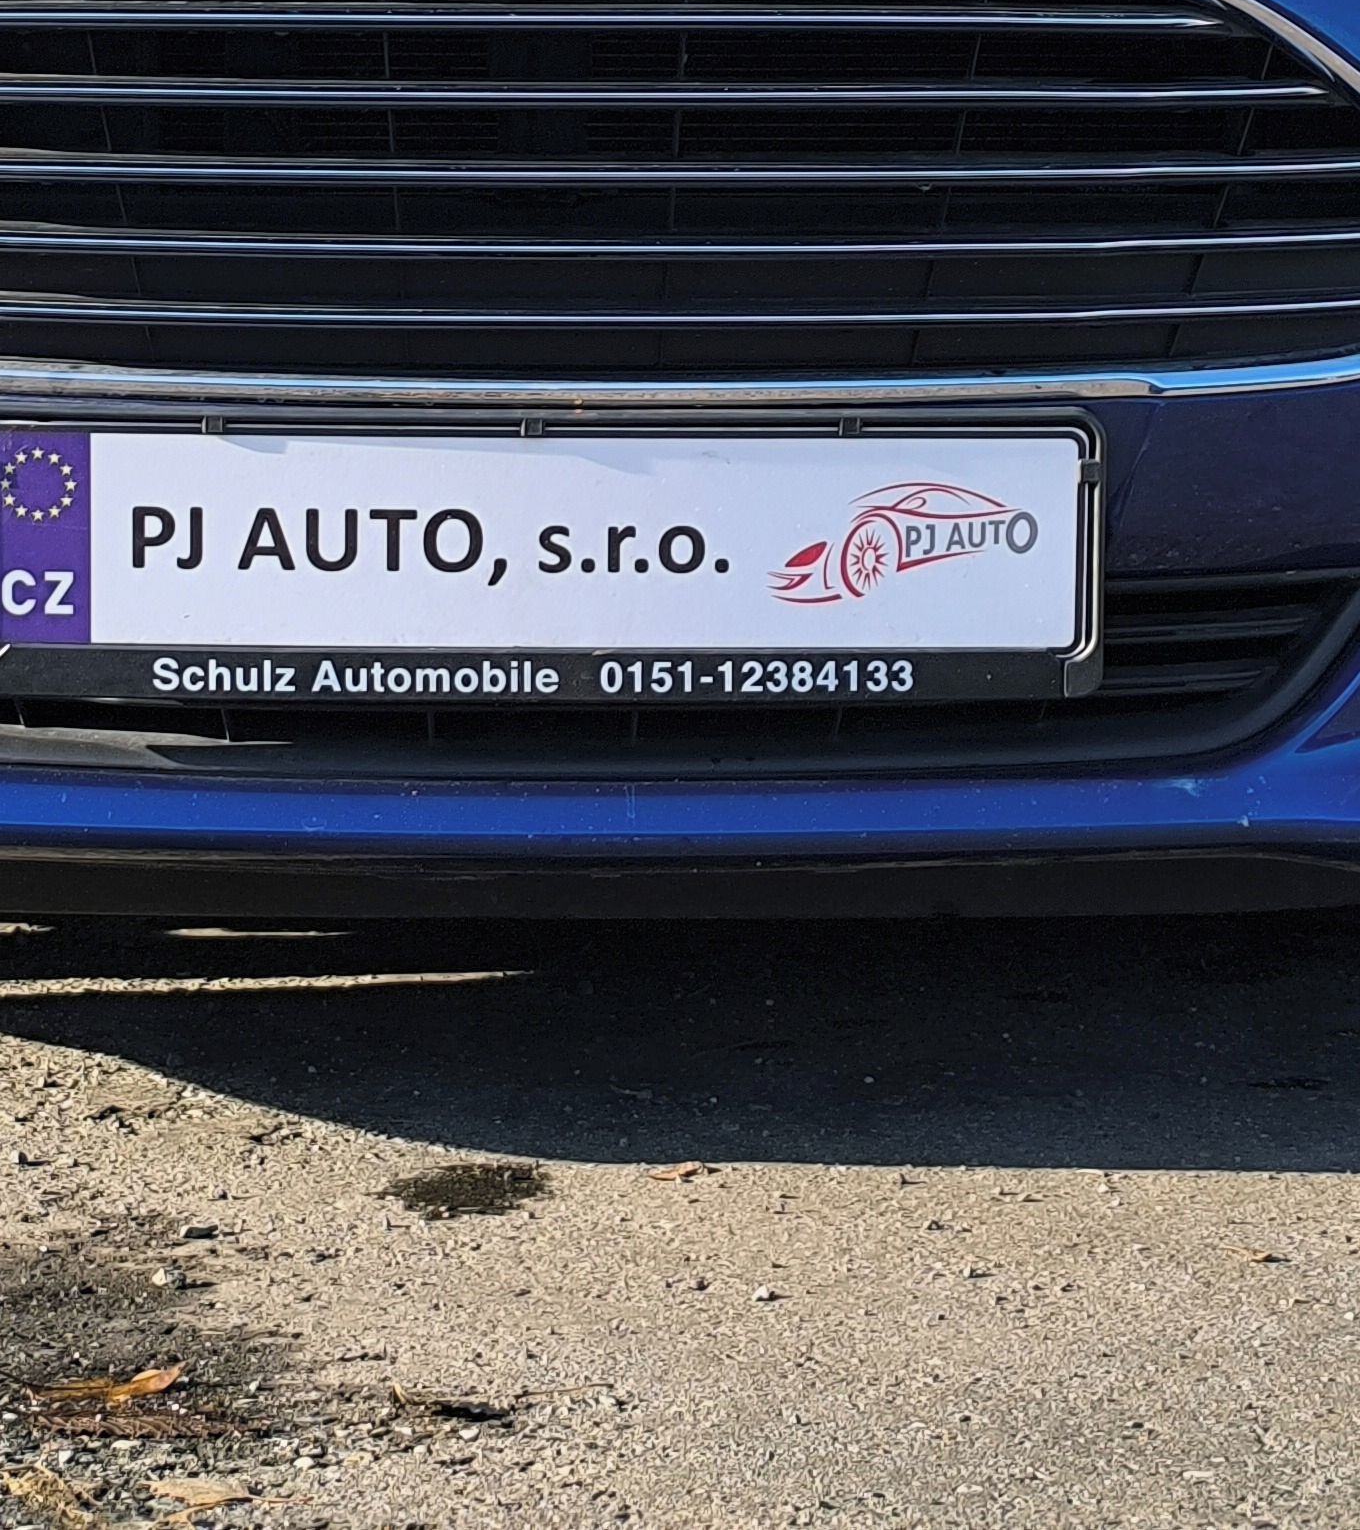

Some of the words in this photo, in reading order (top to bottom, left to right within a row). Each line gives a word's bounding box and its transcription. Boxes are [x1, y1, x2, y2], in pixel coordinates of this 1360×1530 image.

[131, 506, 204, 570] PJ
[237, 507, 509, 587] AUTO,
[537, 525, 730, 574] s.r.o.
[904, 523, 937, 558] PJ
[945, 511, 1039, 555] AUTO
[0, 569, 75, 617] CZ
[152, 657, 296, 693] Schulz
[311, 659, 560, 694] Automobile
[599, 660, 915, 694] 0151-12384133
